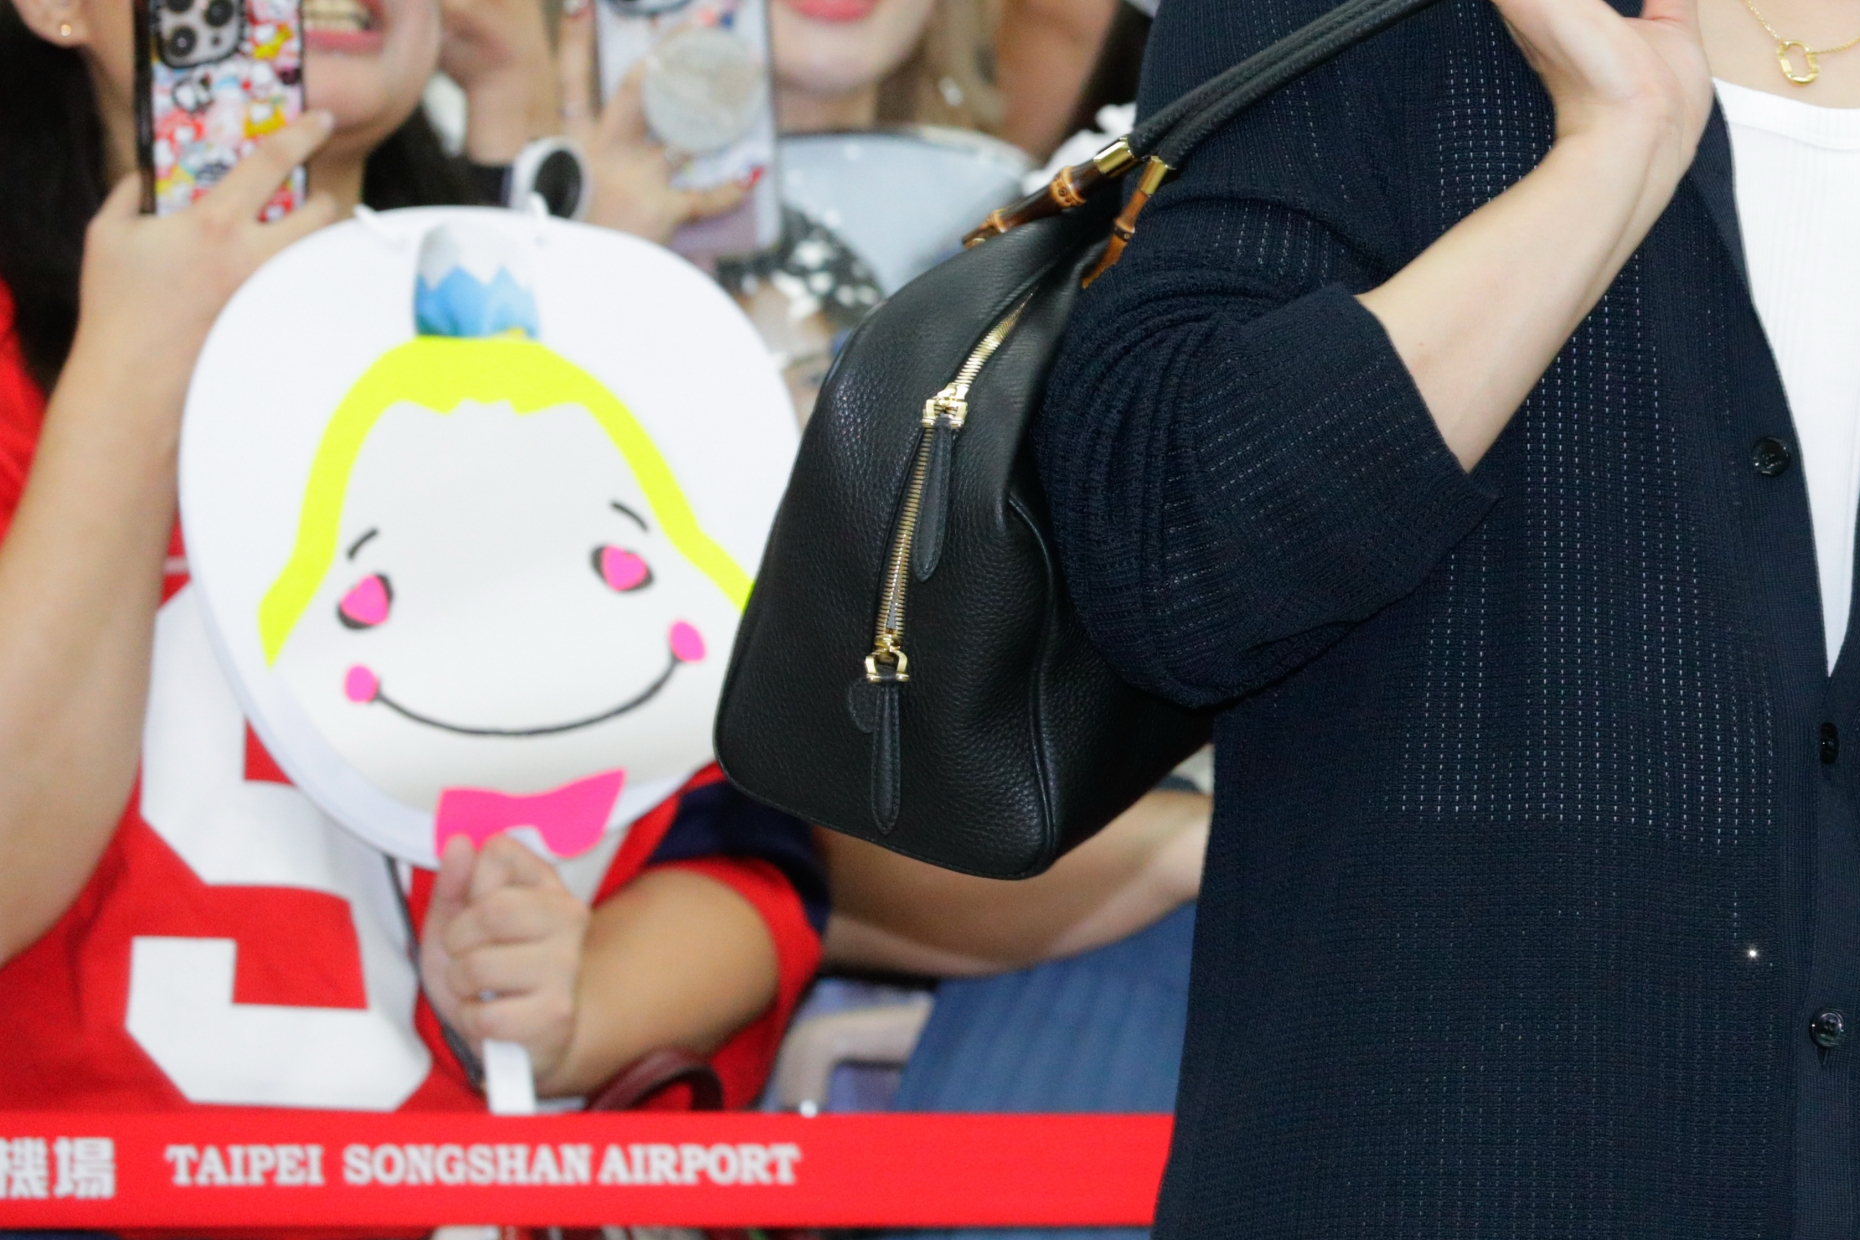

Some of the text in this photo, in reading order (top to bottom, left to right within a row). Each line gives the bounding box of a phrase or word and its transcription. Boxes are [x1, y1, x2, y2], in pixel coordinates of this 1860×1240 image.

[164, 1142, 802, 1187] TAIPEI SONGSHAN AIRPORT
